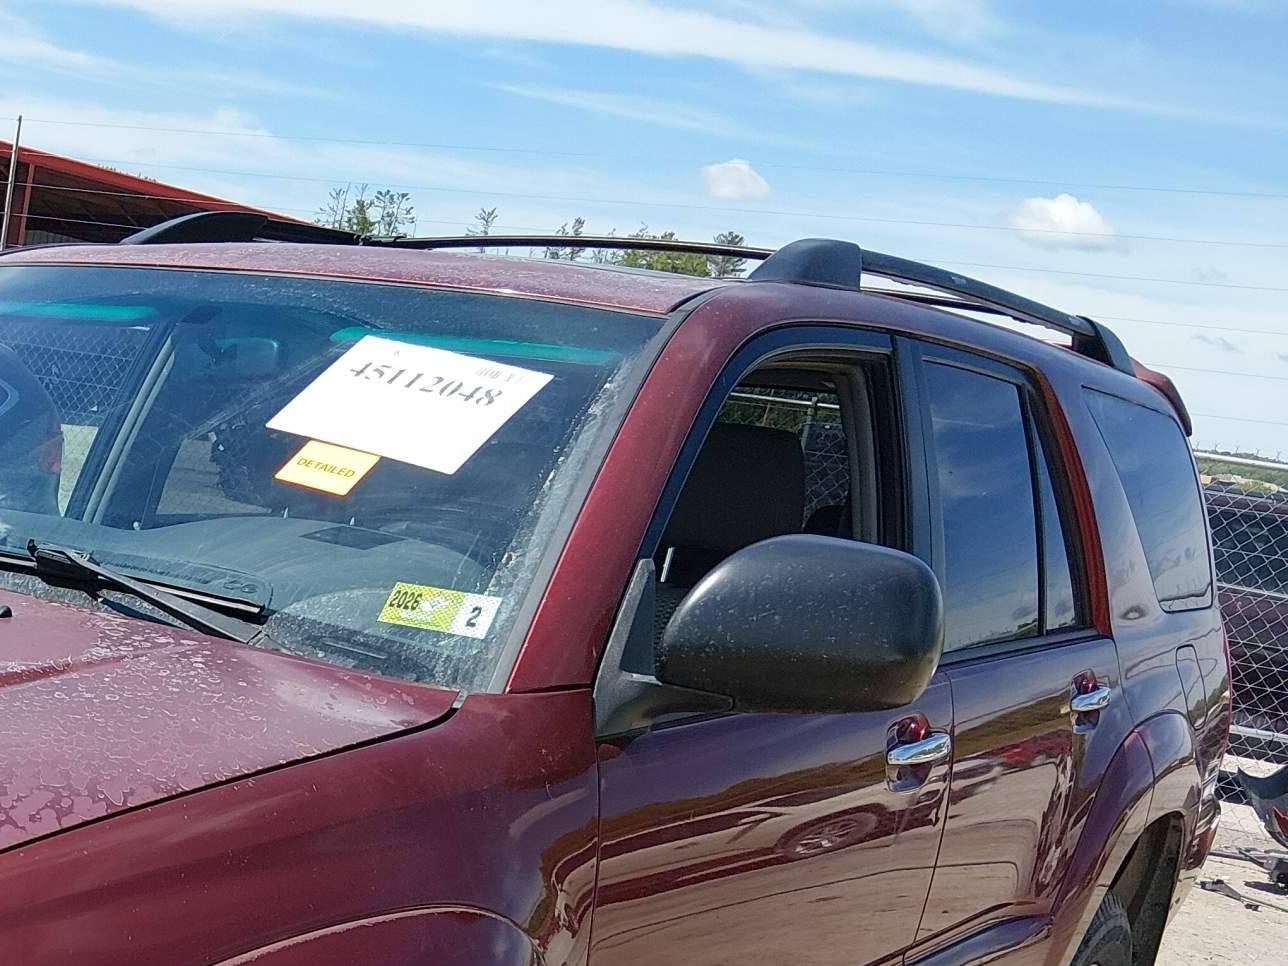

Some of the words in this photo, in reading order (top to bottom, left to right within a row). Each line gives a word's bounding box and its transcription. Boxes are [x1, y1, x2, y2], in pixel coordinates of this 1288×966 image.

[349, 361, 503, 407] 45112048
[296, 457, 356, 478] DETAILED
[388, 589, 423, 612] 2026
[465, 605, 483, 628] 2
